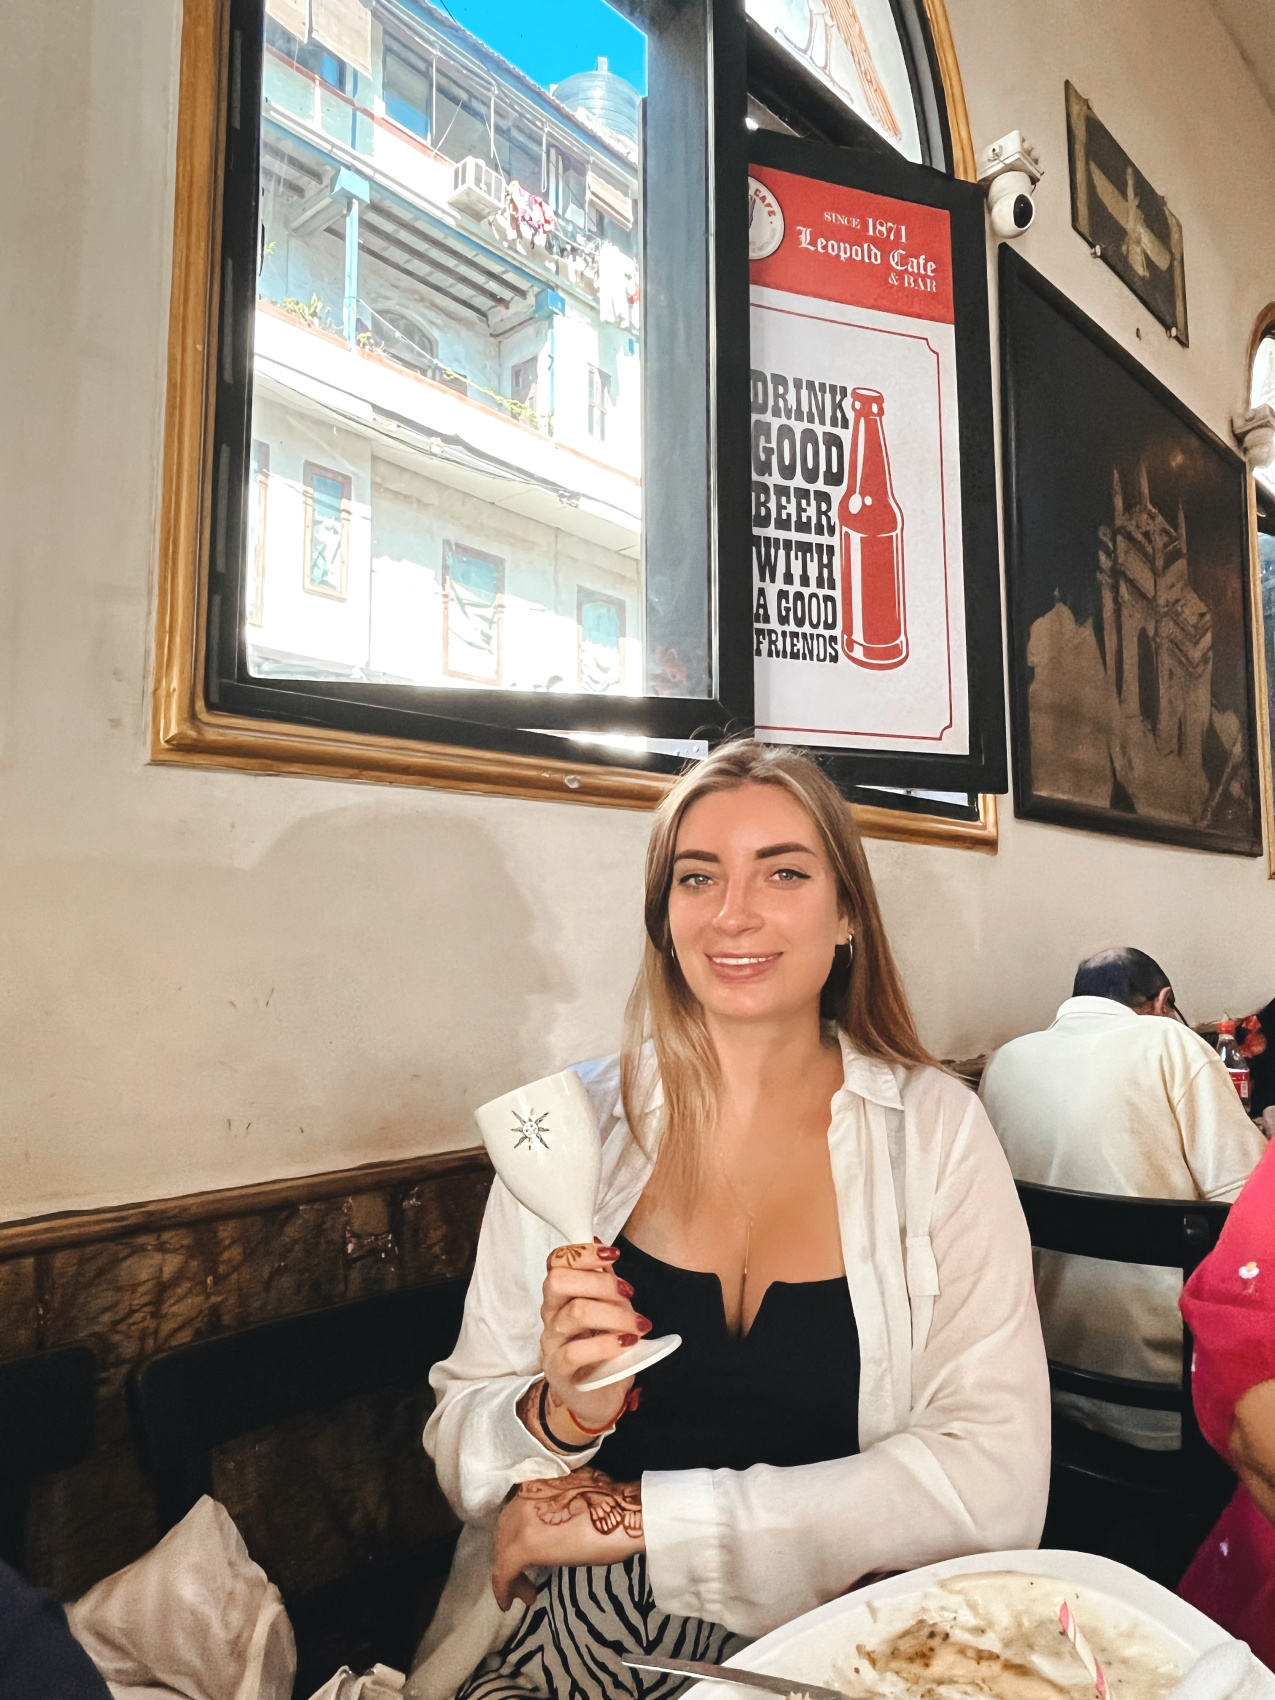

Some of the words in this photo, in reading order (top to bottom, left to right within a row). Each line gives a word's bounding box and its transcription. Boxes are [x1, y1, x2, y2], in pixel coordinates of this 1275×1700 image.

[796, 226, 881, 265] Leopold
[889, 249, 937, 277] Cafe
[824, 212, 861, 229] SINCE
[866, 217, 908, 243] 1871
[888, 272, 899, 285] &
[904, 274, 937, 293] BAR
[750, 369, 849, 430] DRINK
[752, 419, 845, 487] GOOD
[752, 480, 836, 537] BEER
[752, 534, 836, 590] WITH
[754, 587, 770, 624] A
[777, 589, 837, 630] GOOD
[754, 627, 839, 663] FRIENDS
